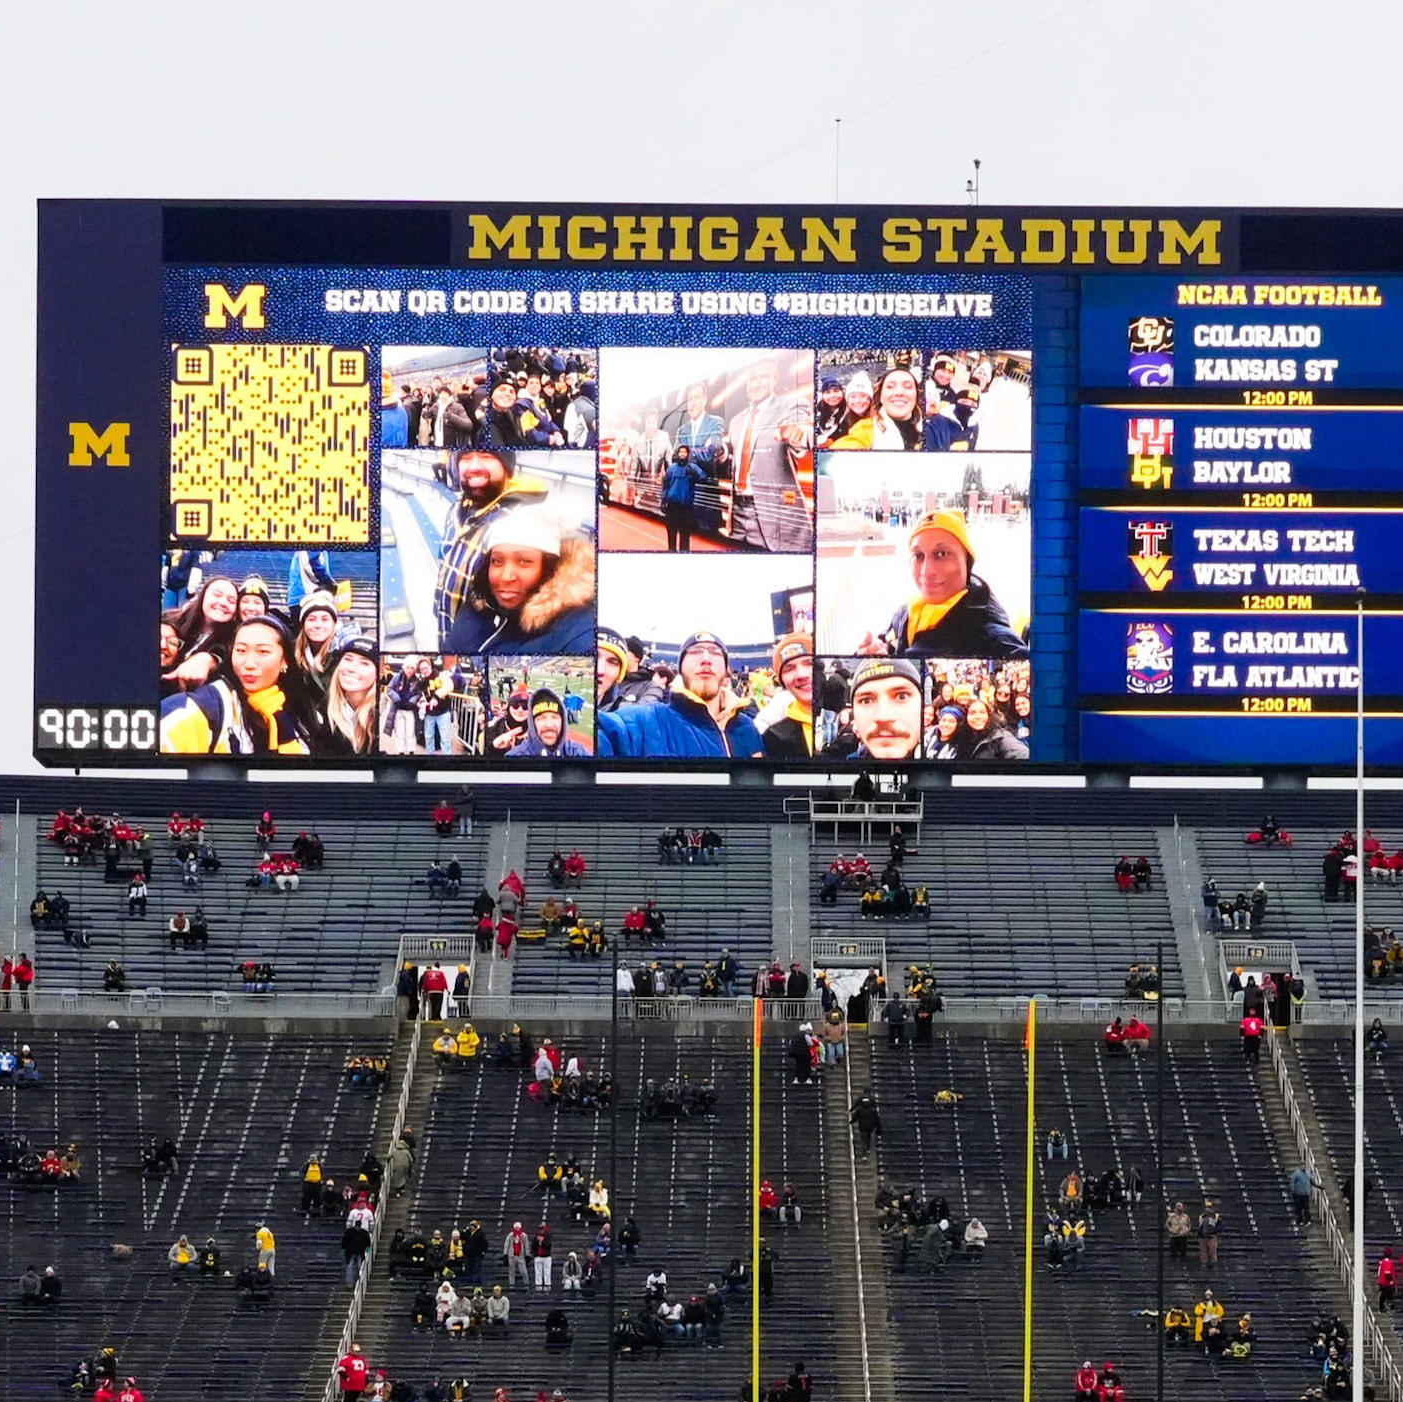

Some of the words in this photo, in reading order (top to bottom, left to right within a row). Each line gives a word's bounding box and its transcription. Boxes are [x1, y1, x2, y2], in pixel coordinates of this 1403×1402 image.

[468, 214, 858, 263] MICHIGAN
[881, 217, 1223, 266] STADIUM
[205, 284, 266, 329] M
[325, 289, 401, 312] SCAN
[408, 290, 447, 316] QR
[454, 291, 527, 313] CODE
[534, 291, 574, 314] OR
[579, 291, 675, 314] SHARE
[680, 292, 767, 315] USING
[774, 293, 993, 317] #BIGHOUSELIVE
[1178, 285, 1247, 306] NCAA
[1254, 285, 1382, 307] FOOTBALL
[1194, 325, 1321, 348] COLORADO
[1195, 359, 1296, 382] KANSAS
[1305, 359, 1339, 382] ST
[1243, 392, 1284, 406] 12:00
[1287, 392, 1313, 406] PM
[69, 422, 131, 467] M
[1194, 427, 1311, 451] HOUSTON
[1194, 461, 1291, 484] BAYLOR
[1243, 494, 1284, 508] 12:00
[1287, 494, 1313, 508] PM
[1194, 530, 1279, 552] TEXAS
[1289, 530, 1354, 553] TECH
[1193, 564, 1256, 586] WEST
[1264, 564, 1360, 587] VIRGINIA
[1243, 597, 1284, 611] 12:00
[1287, 597, 1313, 611] PM
[1193, 632, 1216, 655] E.
[1224, 632, 1347, 655] CAROLINA
[1193, 666, 1238, 688] FLA
[1246, 666, 1361, 689] ATLANTIC
[1242, 699, 1283, 713] 12:00
[1286, 699, 1312, 713] PM
[39, 708, 155, 749] 90:00
